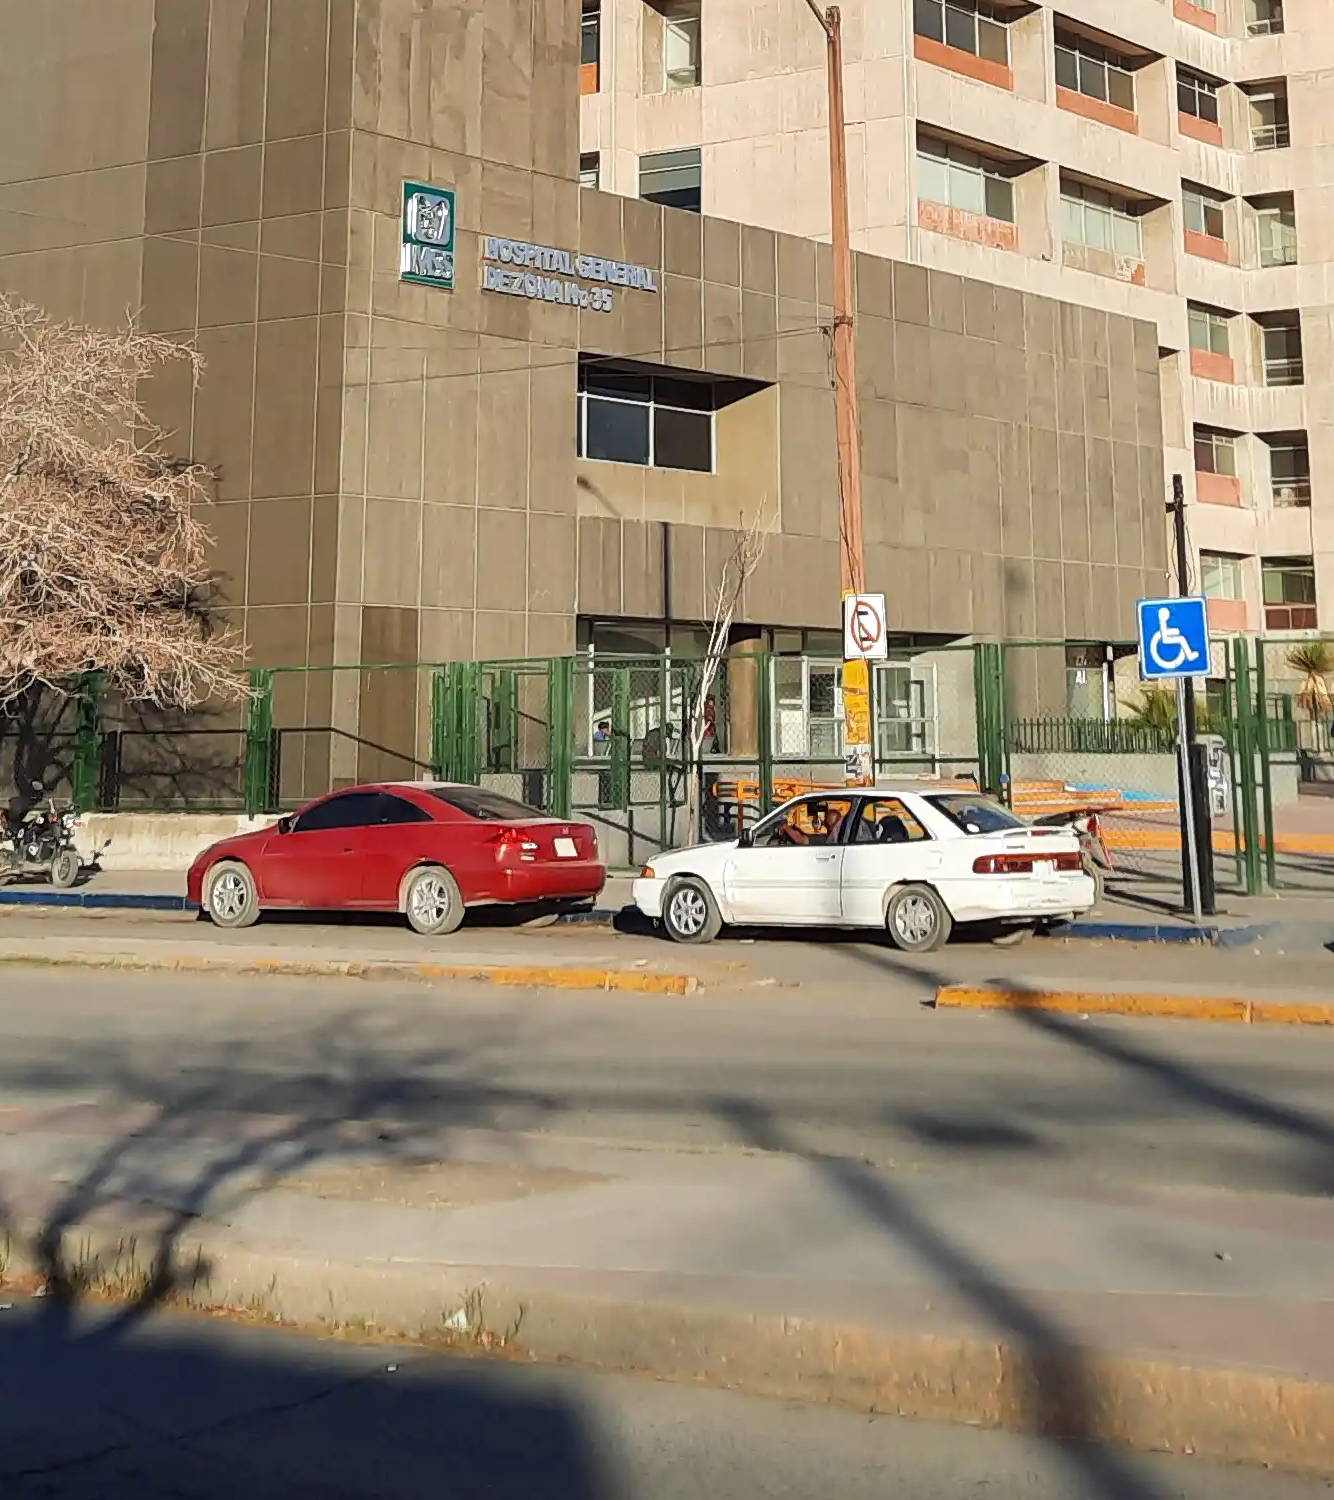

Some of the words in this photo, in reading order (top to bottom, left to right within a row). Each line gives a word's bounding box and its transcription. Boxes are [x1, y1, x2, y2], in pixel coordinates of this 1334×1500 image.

[400, 242, 454, 279] IMSS
[484, 236, 574, 276] HOSPITAL
[576, 255, 658, 293] GENERAL
